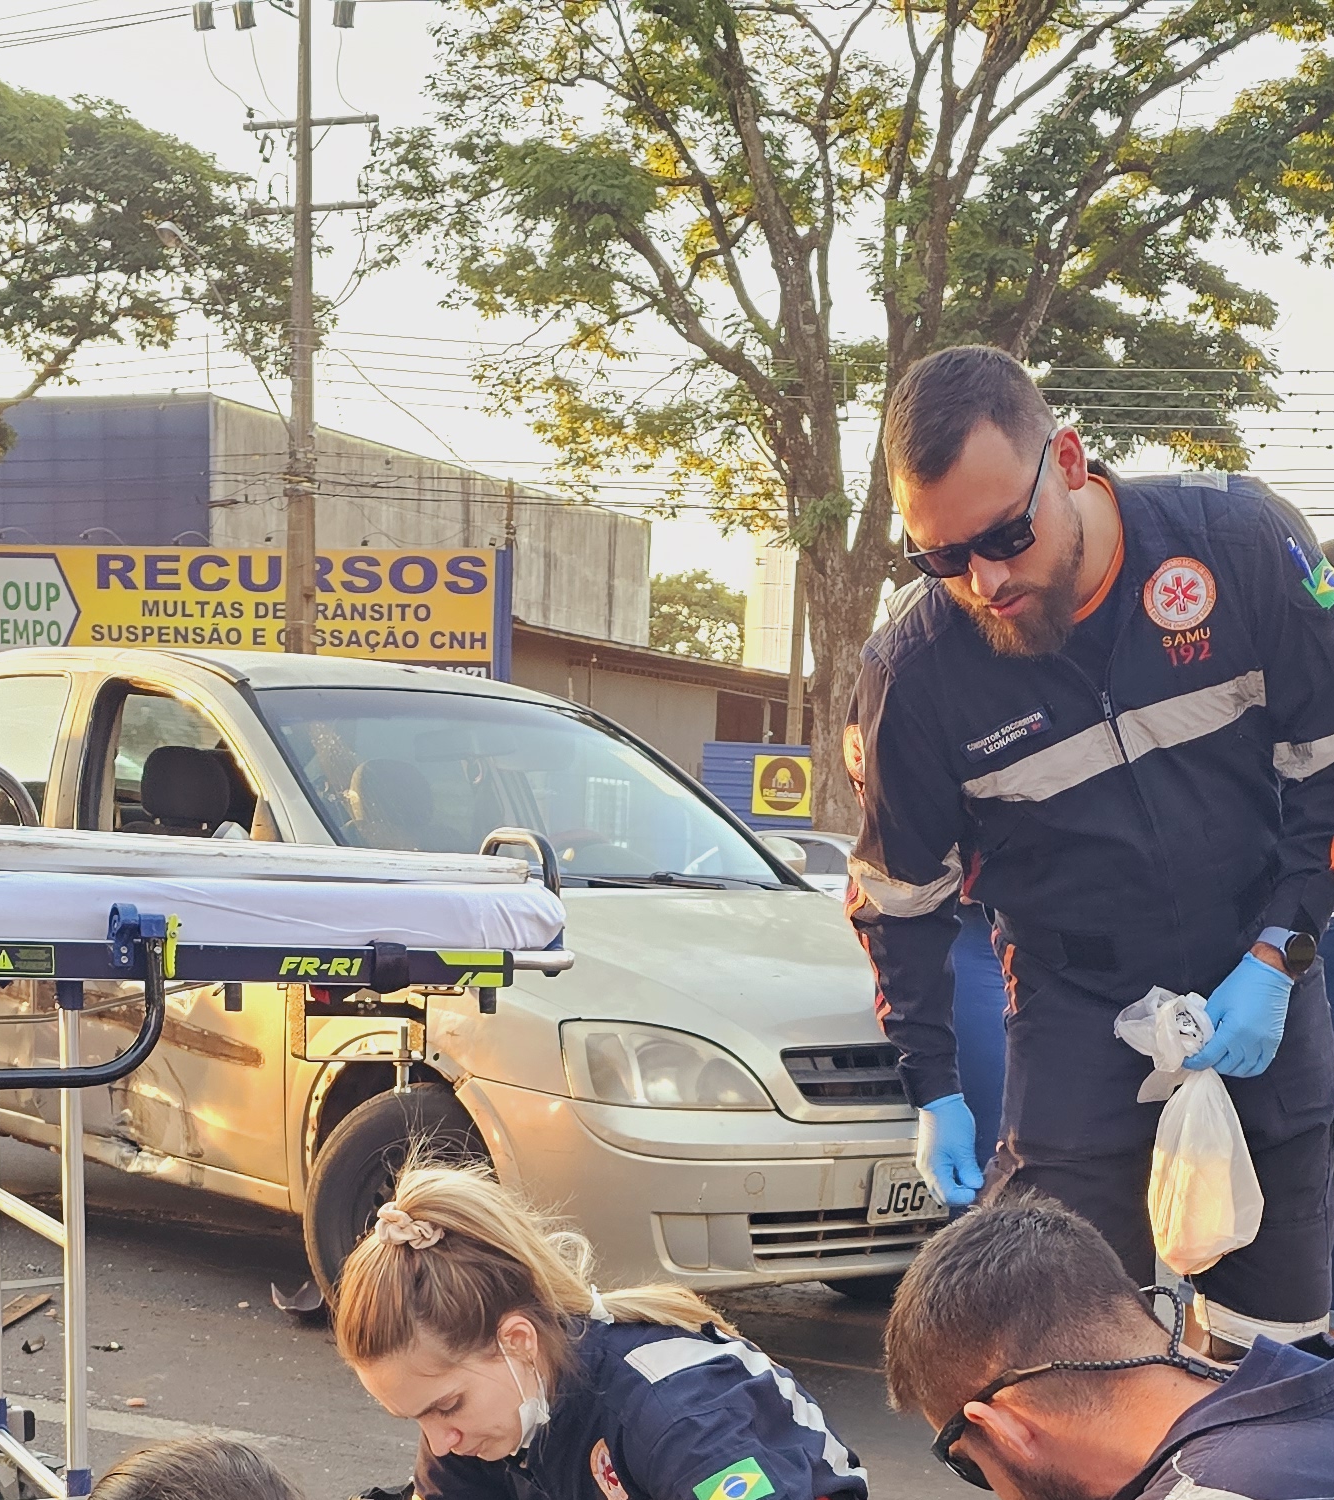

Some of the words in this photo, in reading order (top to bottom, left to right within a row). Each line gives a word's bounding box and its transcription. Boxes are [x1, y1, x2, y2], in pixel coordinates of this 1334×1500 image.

[96, 554, 489, 595] RECURSOS
[141, 599, 244, 620] MULTAS
[254, 601, 286, 620] DE
[316, 598, 432, 622] RÂNSITO
[90, 621, 243, 646] SUSPENSÃO
[252, 627, 267, 646] E
[276, 626, 420, 653] CSSAÇÃO
[429, 631, 487, 650] CNH
[1162, 626, 1211, 648] SAMU
[1166, 640, 1212, 668] 192
[983, 727, 1028, 755] LEONARDO
[278, 956, 363, 977] FR-R1
[876, 1180, 928, 1215] JGG
